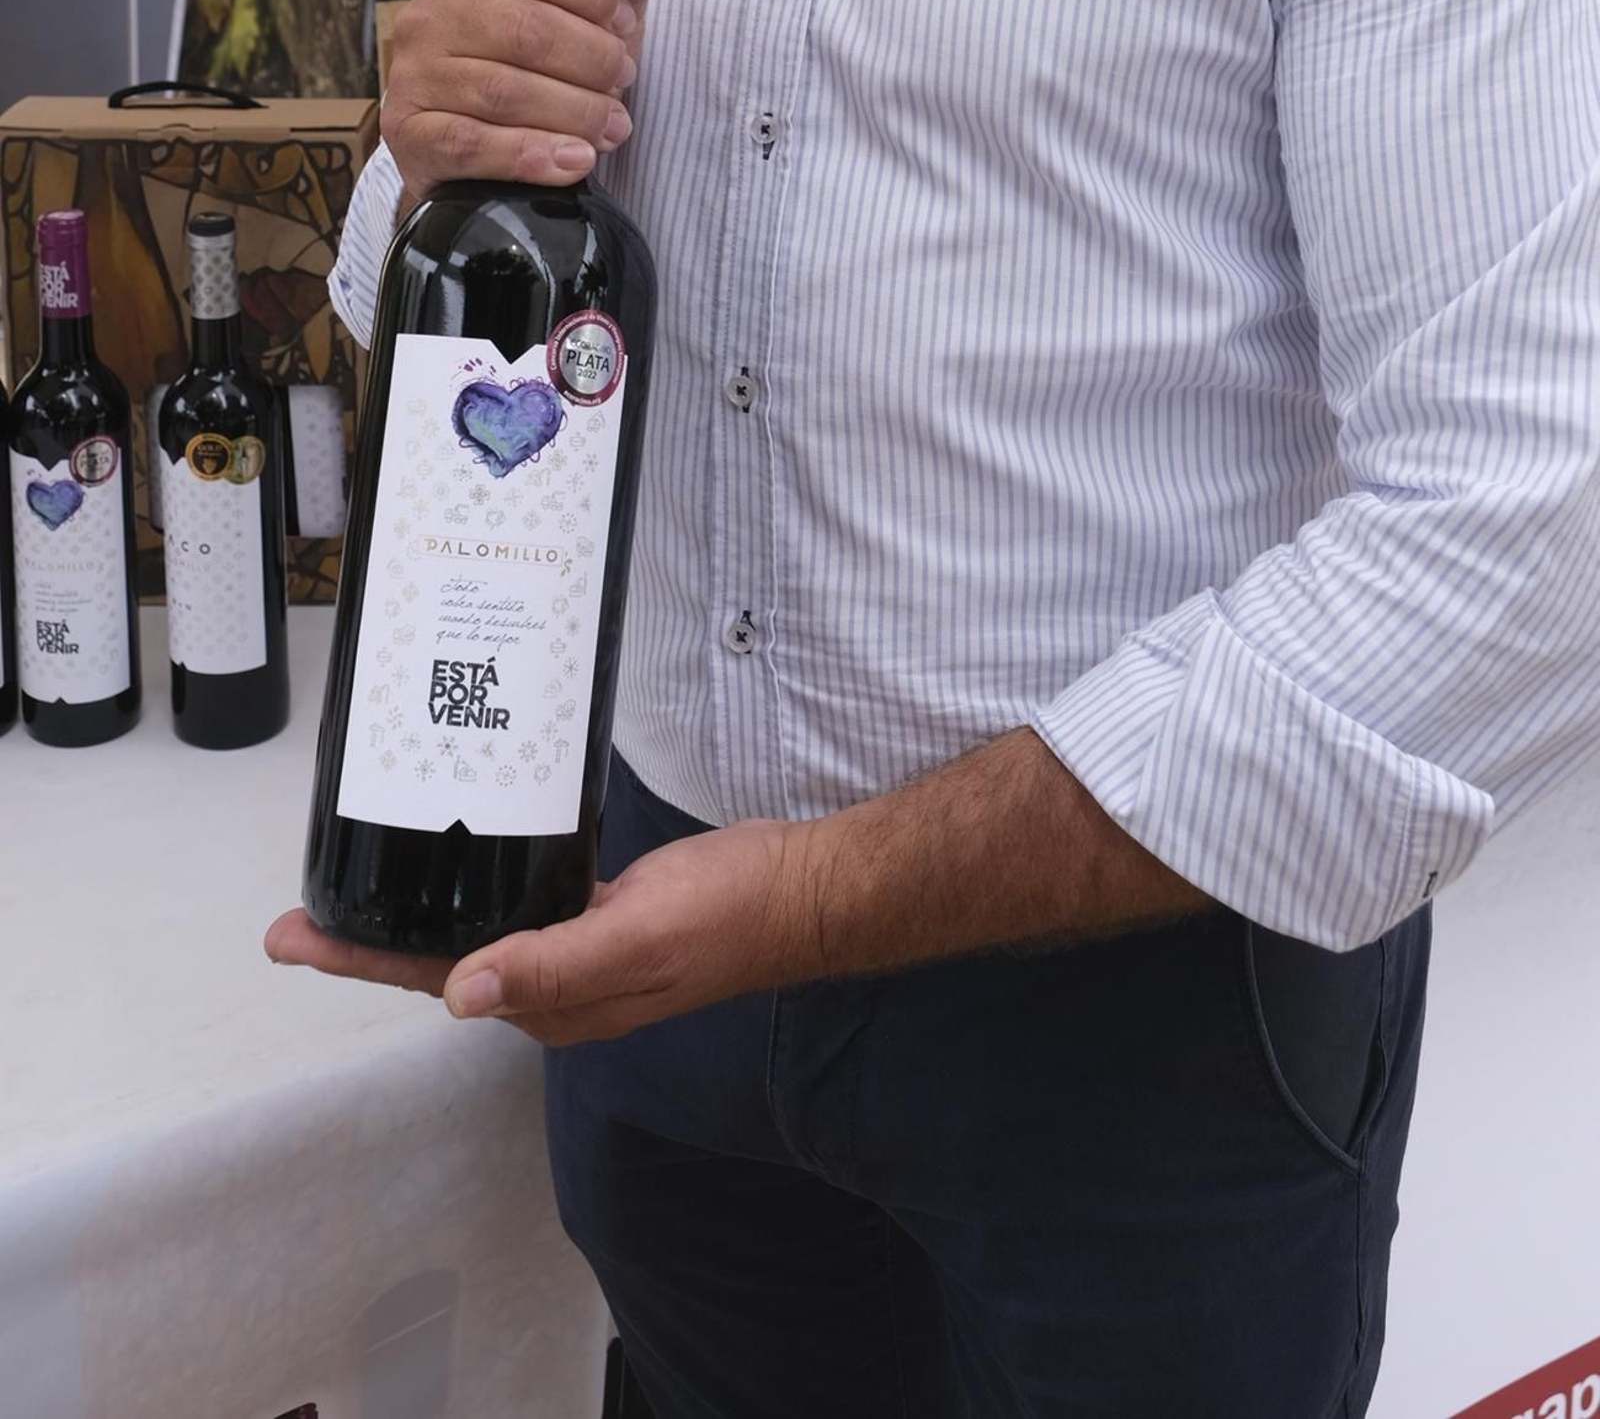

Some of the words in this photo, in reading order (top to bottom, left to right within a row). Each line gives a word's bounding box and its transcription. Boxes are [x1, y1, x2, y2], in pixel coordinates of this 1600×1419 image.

[566, 350, 609, 373] PLATA
[577, 368, 597, 380] 2022
[425, 538, 558, 563] PALOMILLO
[36, 619, 70, 634] ESTÁ
[37, 630, 65, 643] POR
[37, 641, 79, 654] VENIR
[432, 656, 499, 686] ESTÁ
[429, 681, 488, 707] POR
[428, 702, 510, 730] VENIR
[1510, 1373, 1600, 1419] ap
